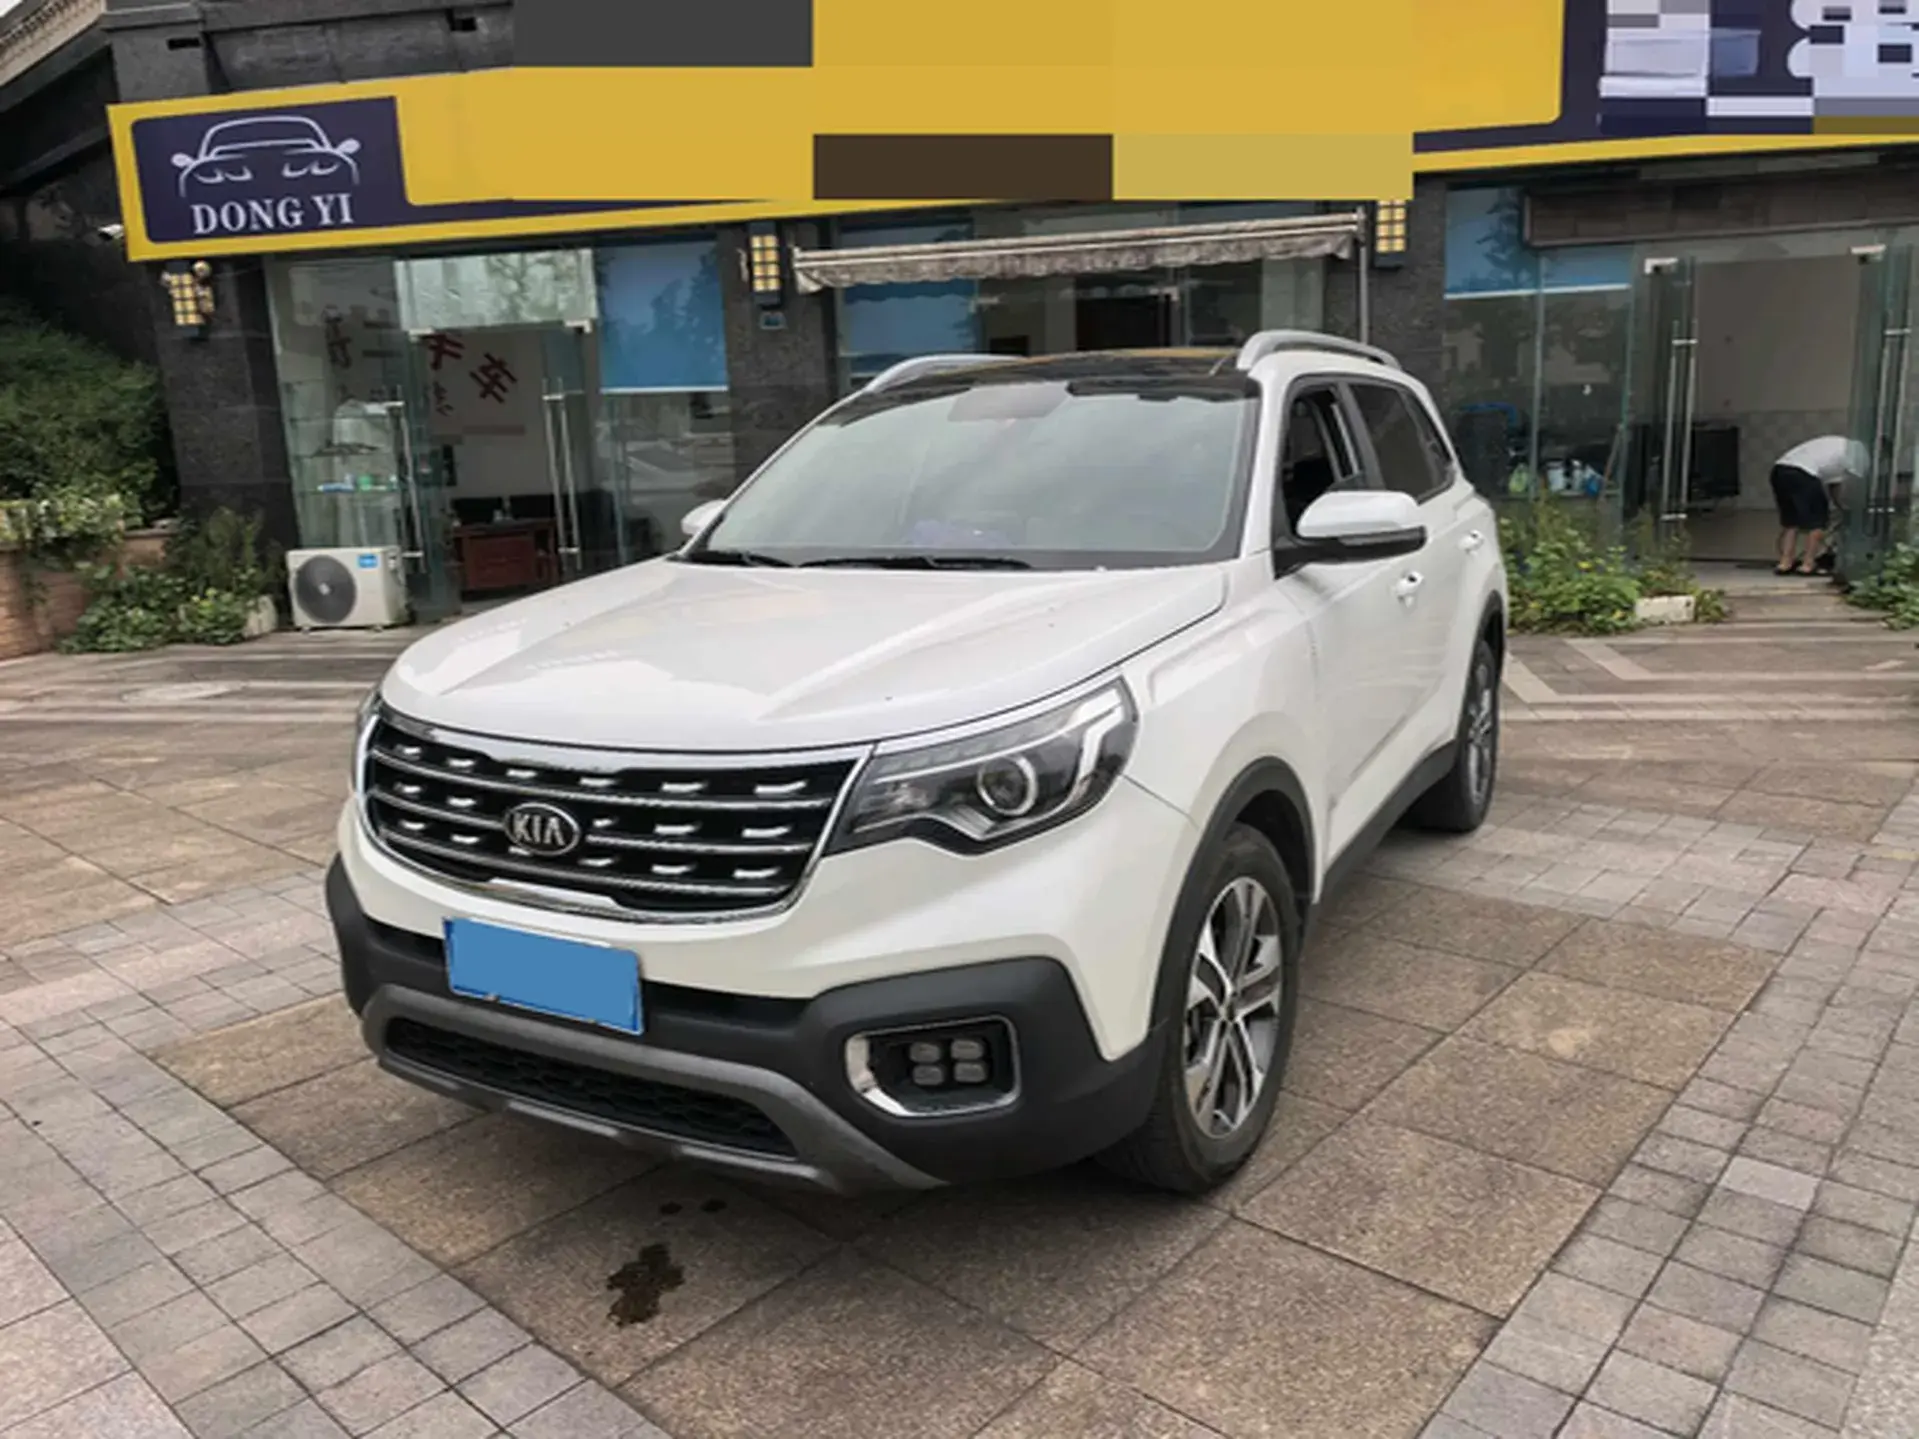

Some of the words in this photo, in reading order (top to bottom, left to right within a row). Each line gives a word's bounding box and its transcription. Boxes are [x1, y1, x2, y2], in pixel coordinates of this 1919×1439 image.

[191, 197, 304, 234] DONG
[311, 193, 354, 225] YI
[512, 812, 565, 846] KIA
